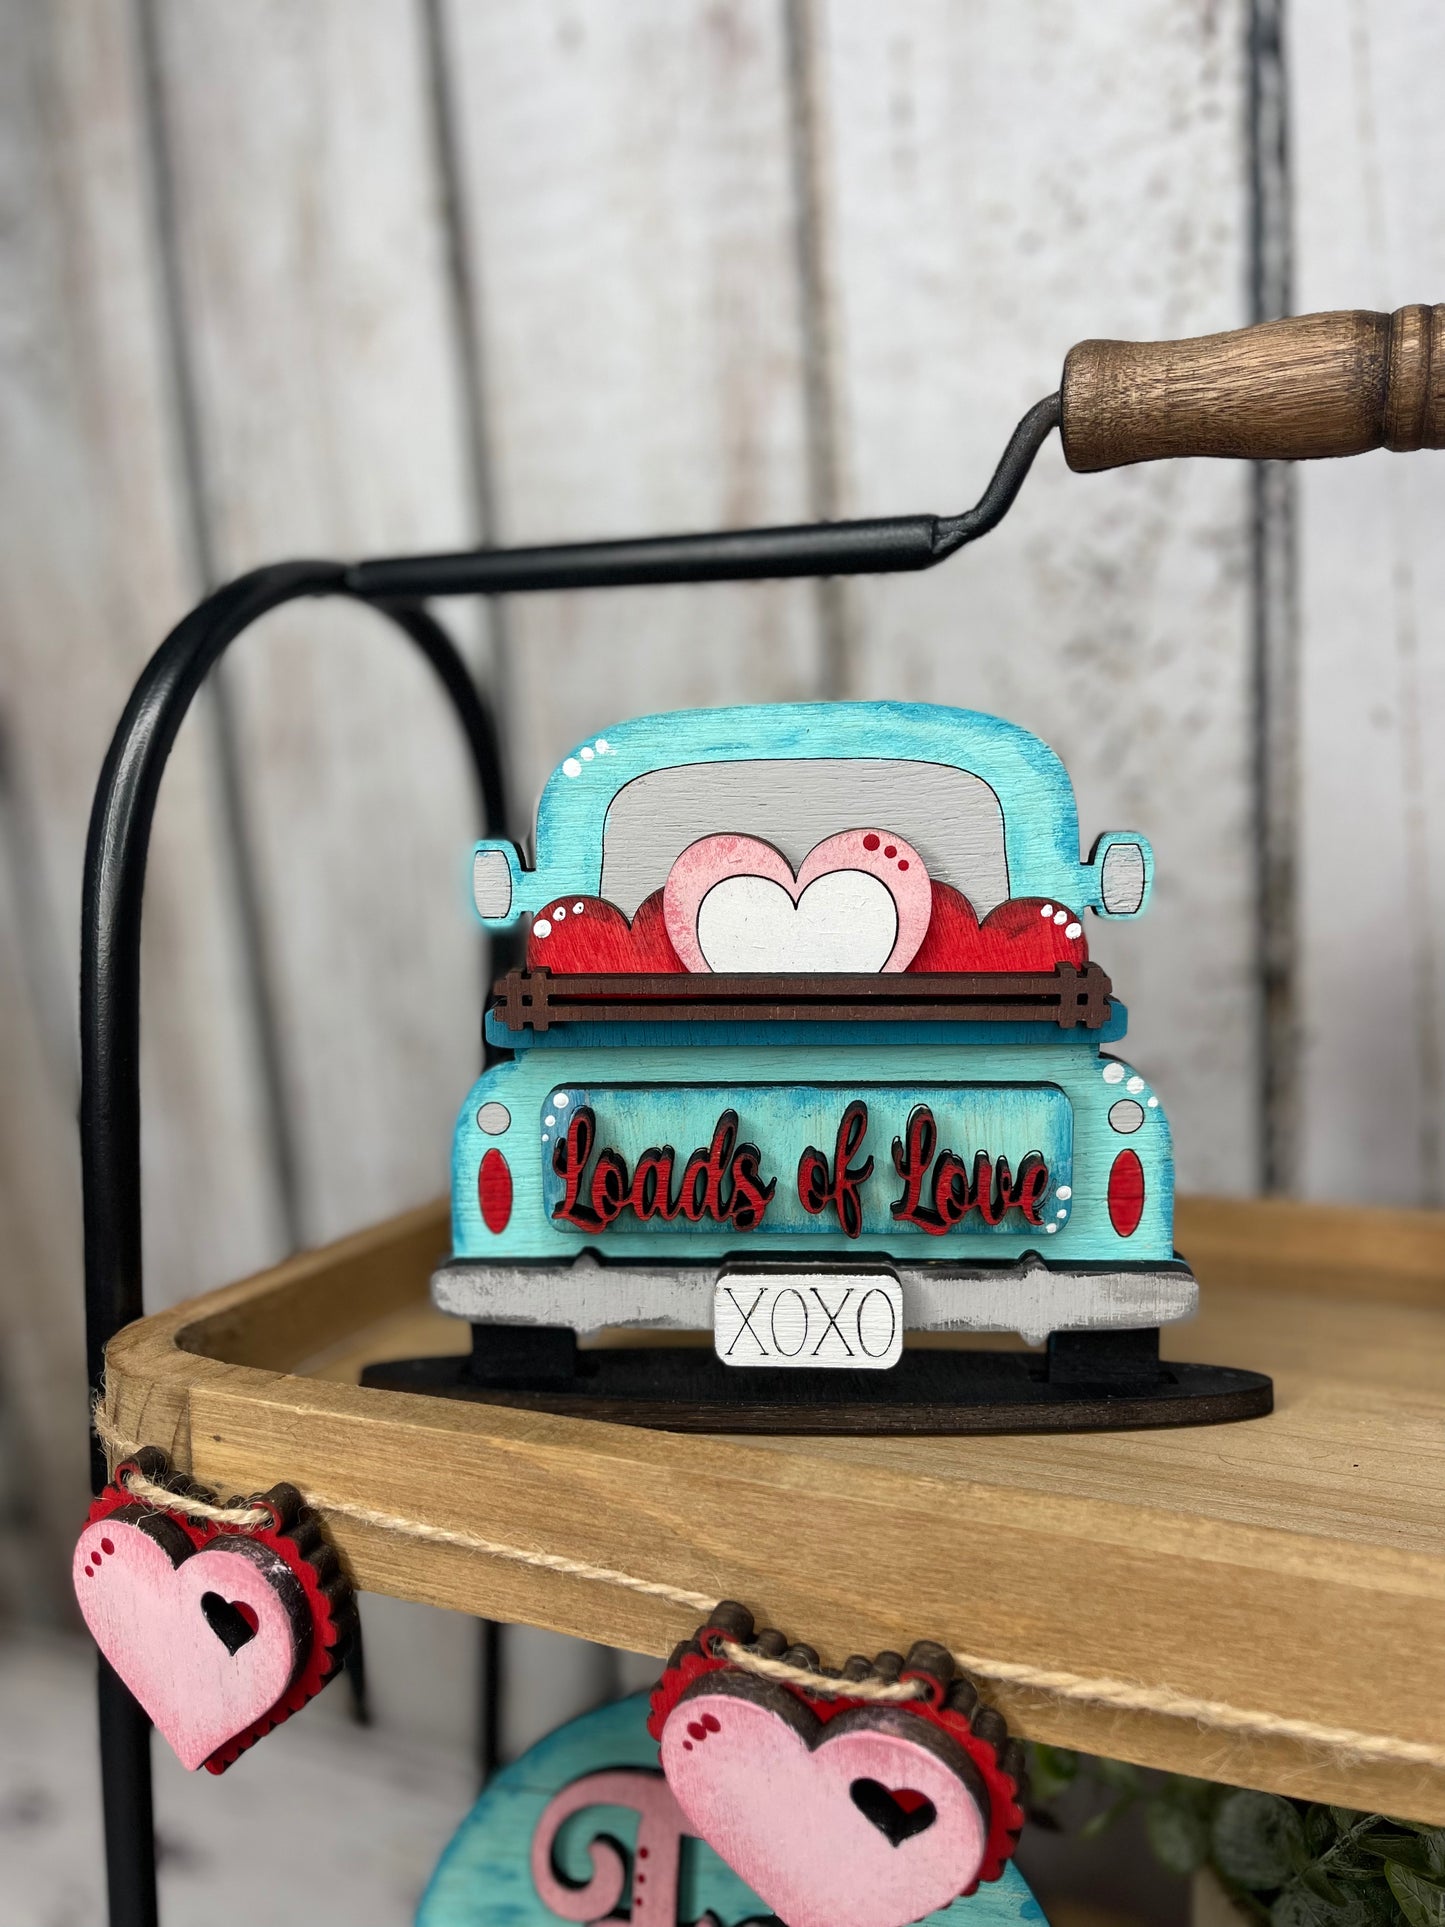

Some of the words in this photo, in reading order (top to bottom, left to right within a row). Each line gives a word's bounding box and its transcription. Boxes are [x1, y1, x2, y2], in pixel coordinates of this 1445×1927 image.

[552, 1104, 777, 1234] Loads
[798, 1099, 875, 1239] of
[890, 1103, 1050, 1236] Love
[725, 1287, 897, 1358] XOXO
